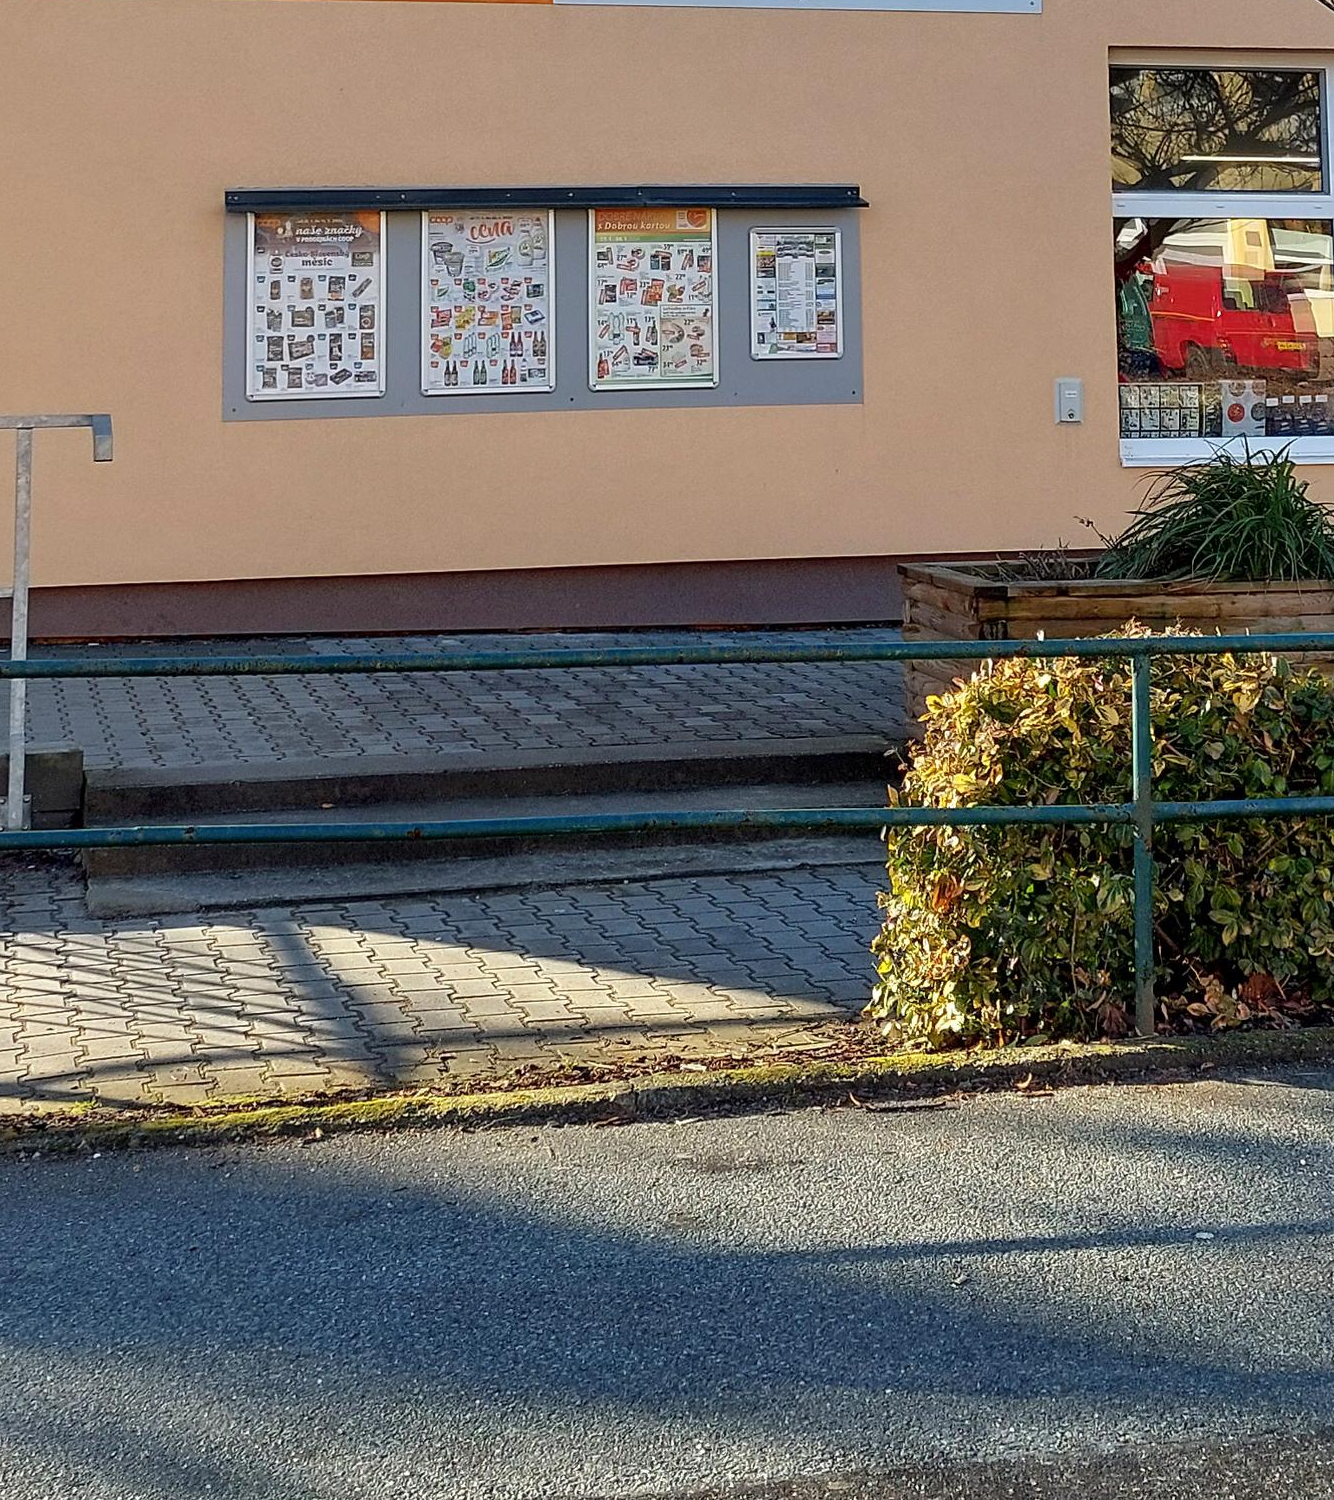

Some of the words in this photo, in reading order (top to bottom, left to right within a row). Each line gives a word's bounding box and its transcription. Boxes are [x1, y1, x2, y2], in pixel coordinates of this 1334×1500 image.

[604, 221, 638, 230] Dobrou
[639, 221, 671, 230] kartou
[295, 225, 322, 236] naše
[324, 225, 363, 238] značky
[301, 257, 333, 267] měsíc
